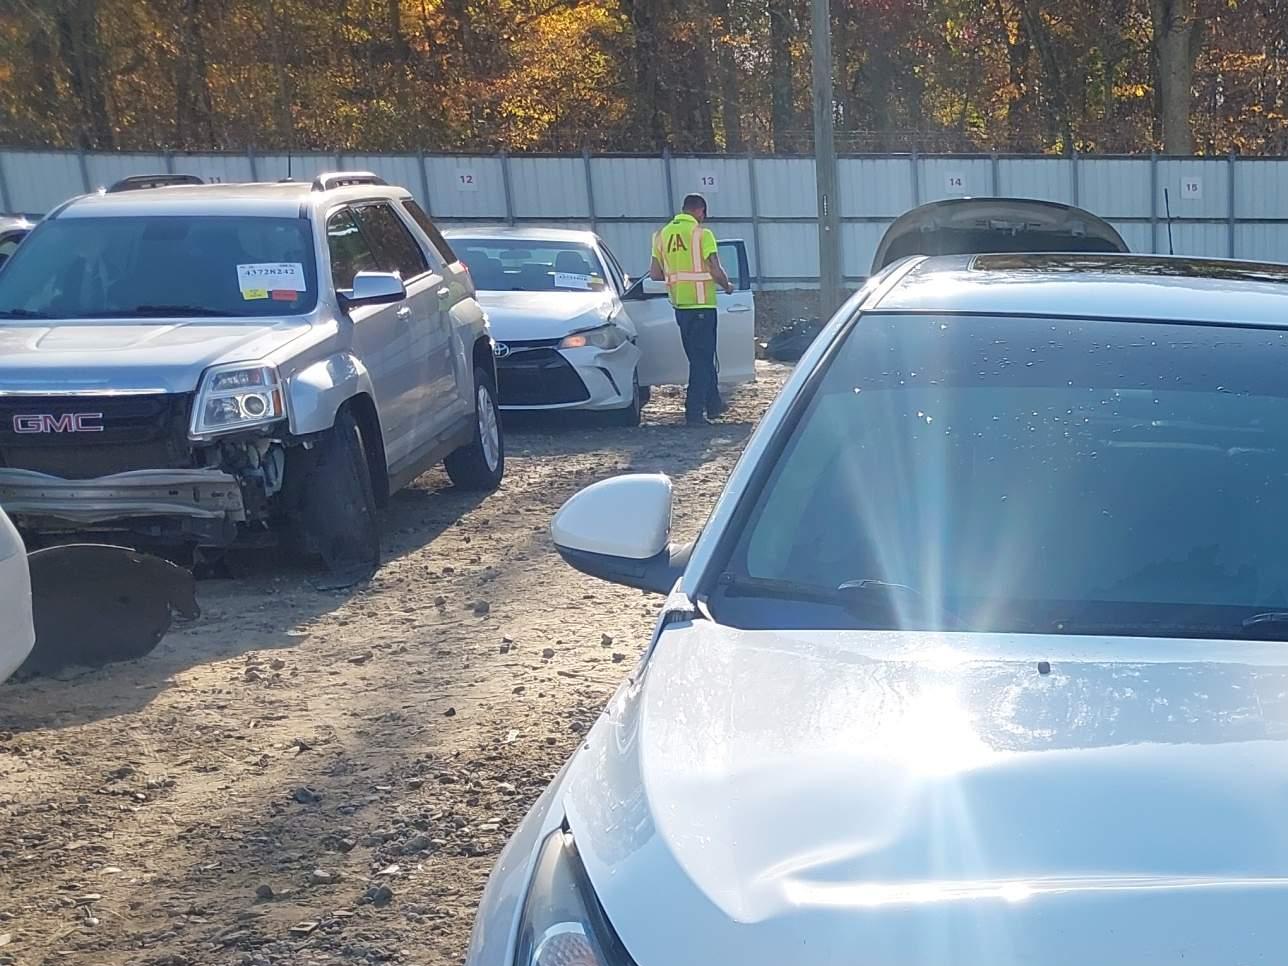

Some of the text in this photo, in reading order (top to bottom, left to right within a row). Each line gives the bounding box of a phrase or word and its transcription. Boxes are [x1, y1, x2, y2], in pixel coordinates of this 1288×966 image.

[460, 175, 473, 184] 12
[702, 176, 714, 186] 13
[950, 177, 962, 186] 14
[1186, 183, 1198, 192] 15
[13, 412, 104, 434] GMC
